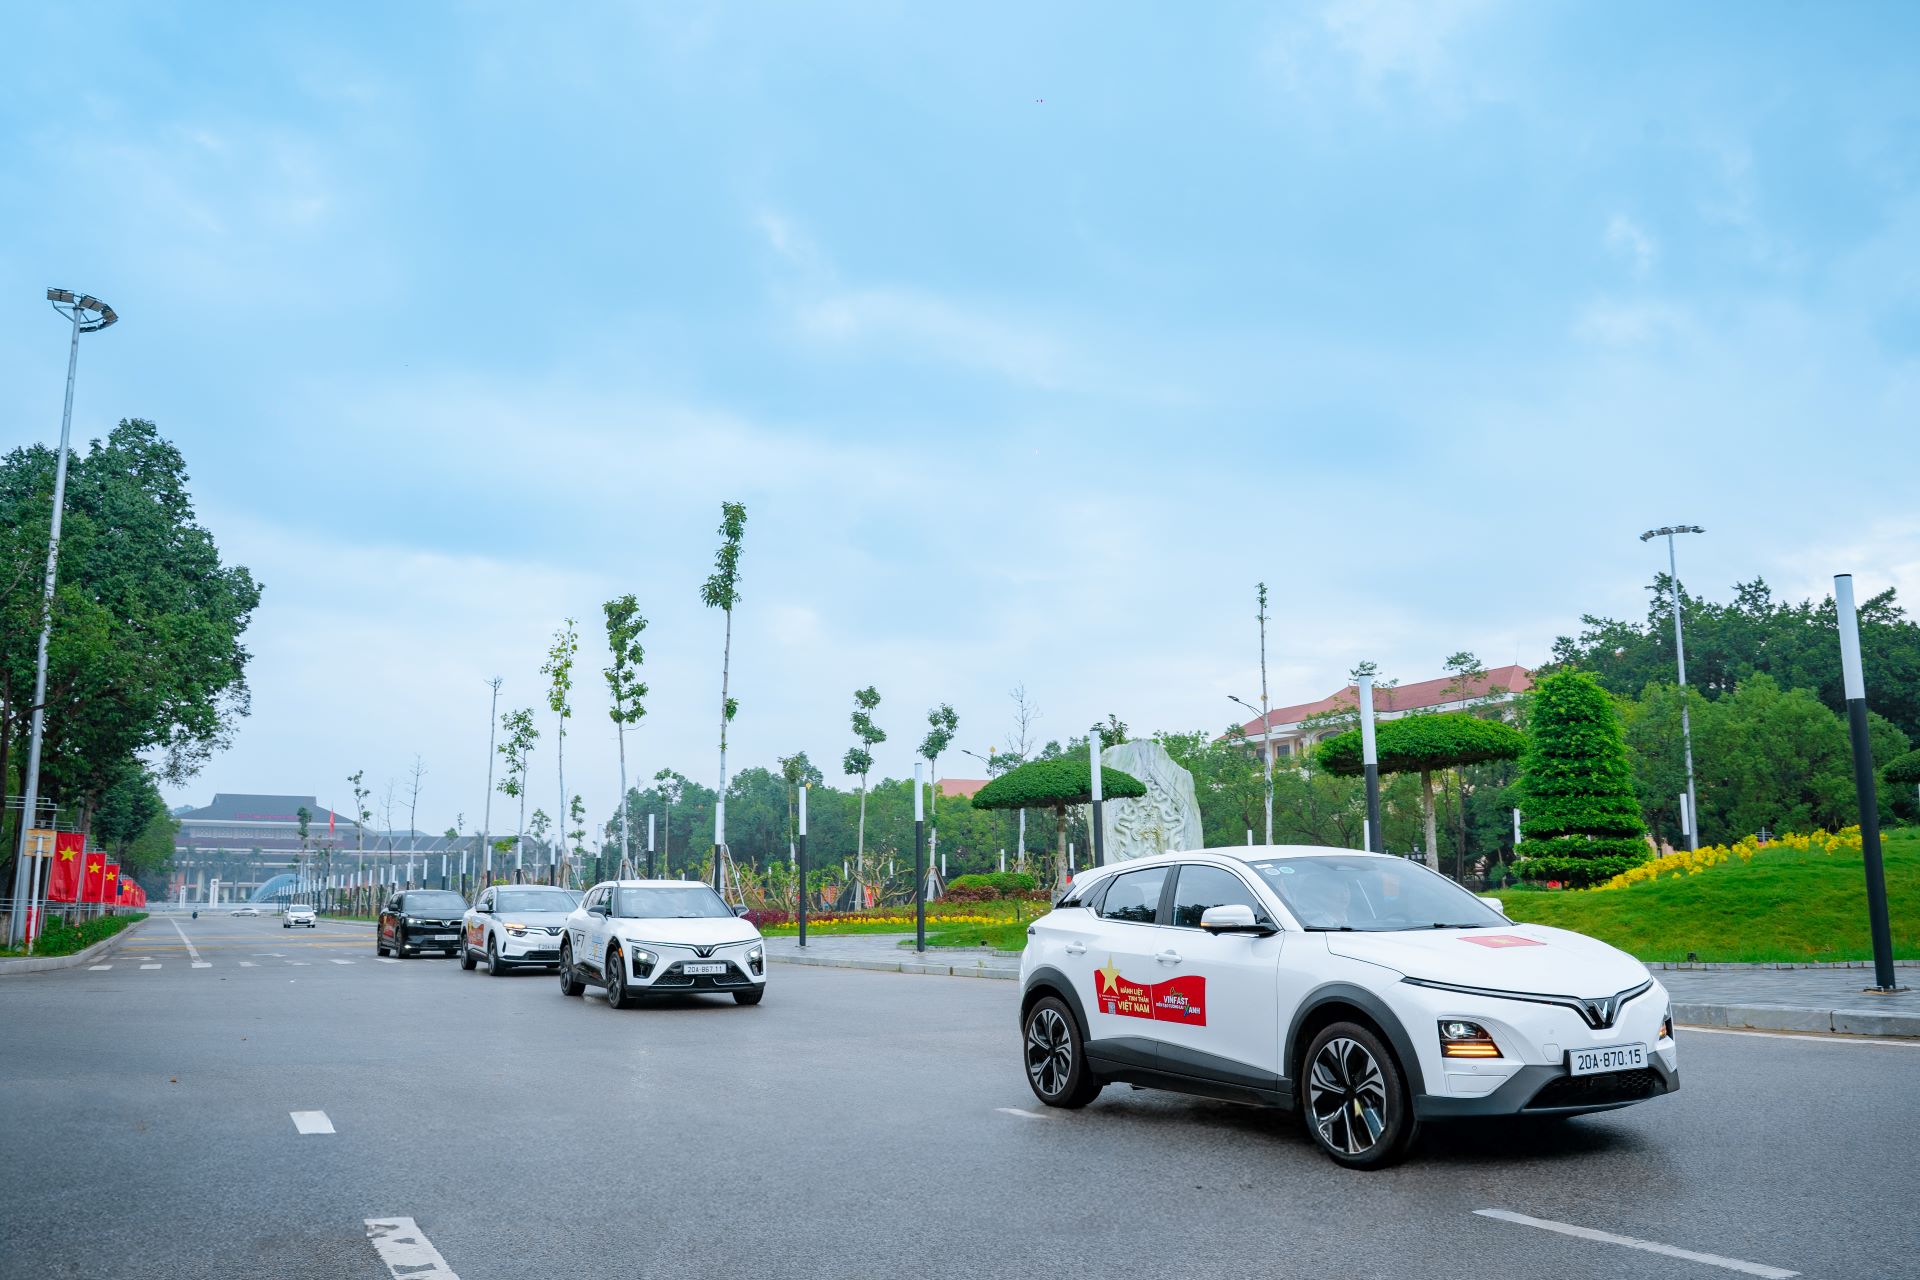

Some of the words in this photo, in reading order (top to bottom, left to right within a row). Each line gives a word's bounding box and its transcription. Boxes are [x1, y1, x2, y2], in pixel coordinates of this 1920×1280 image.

[1117, 1000, 1132, 1012] VIỆT
[1134, 1003, 1150, 1013] NAM
[1163, 995, 1188, 1006] VINFAST
[1578, 1049, 1641, 1070] 20A-870.15
